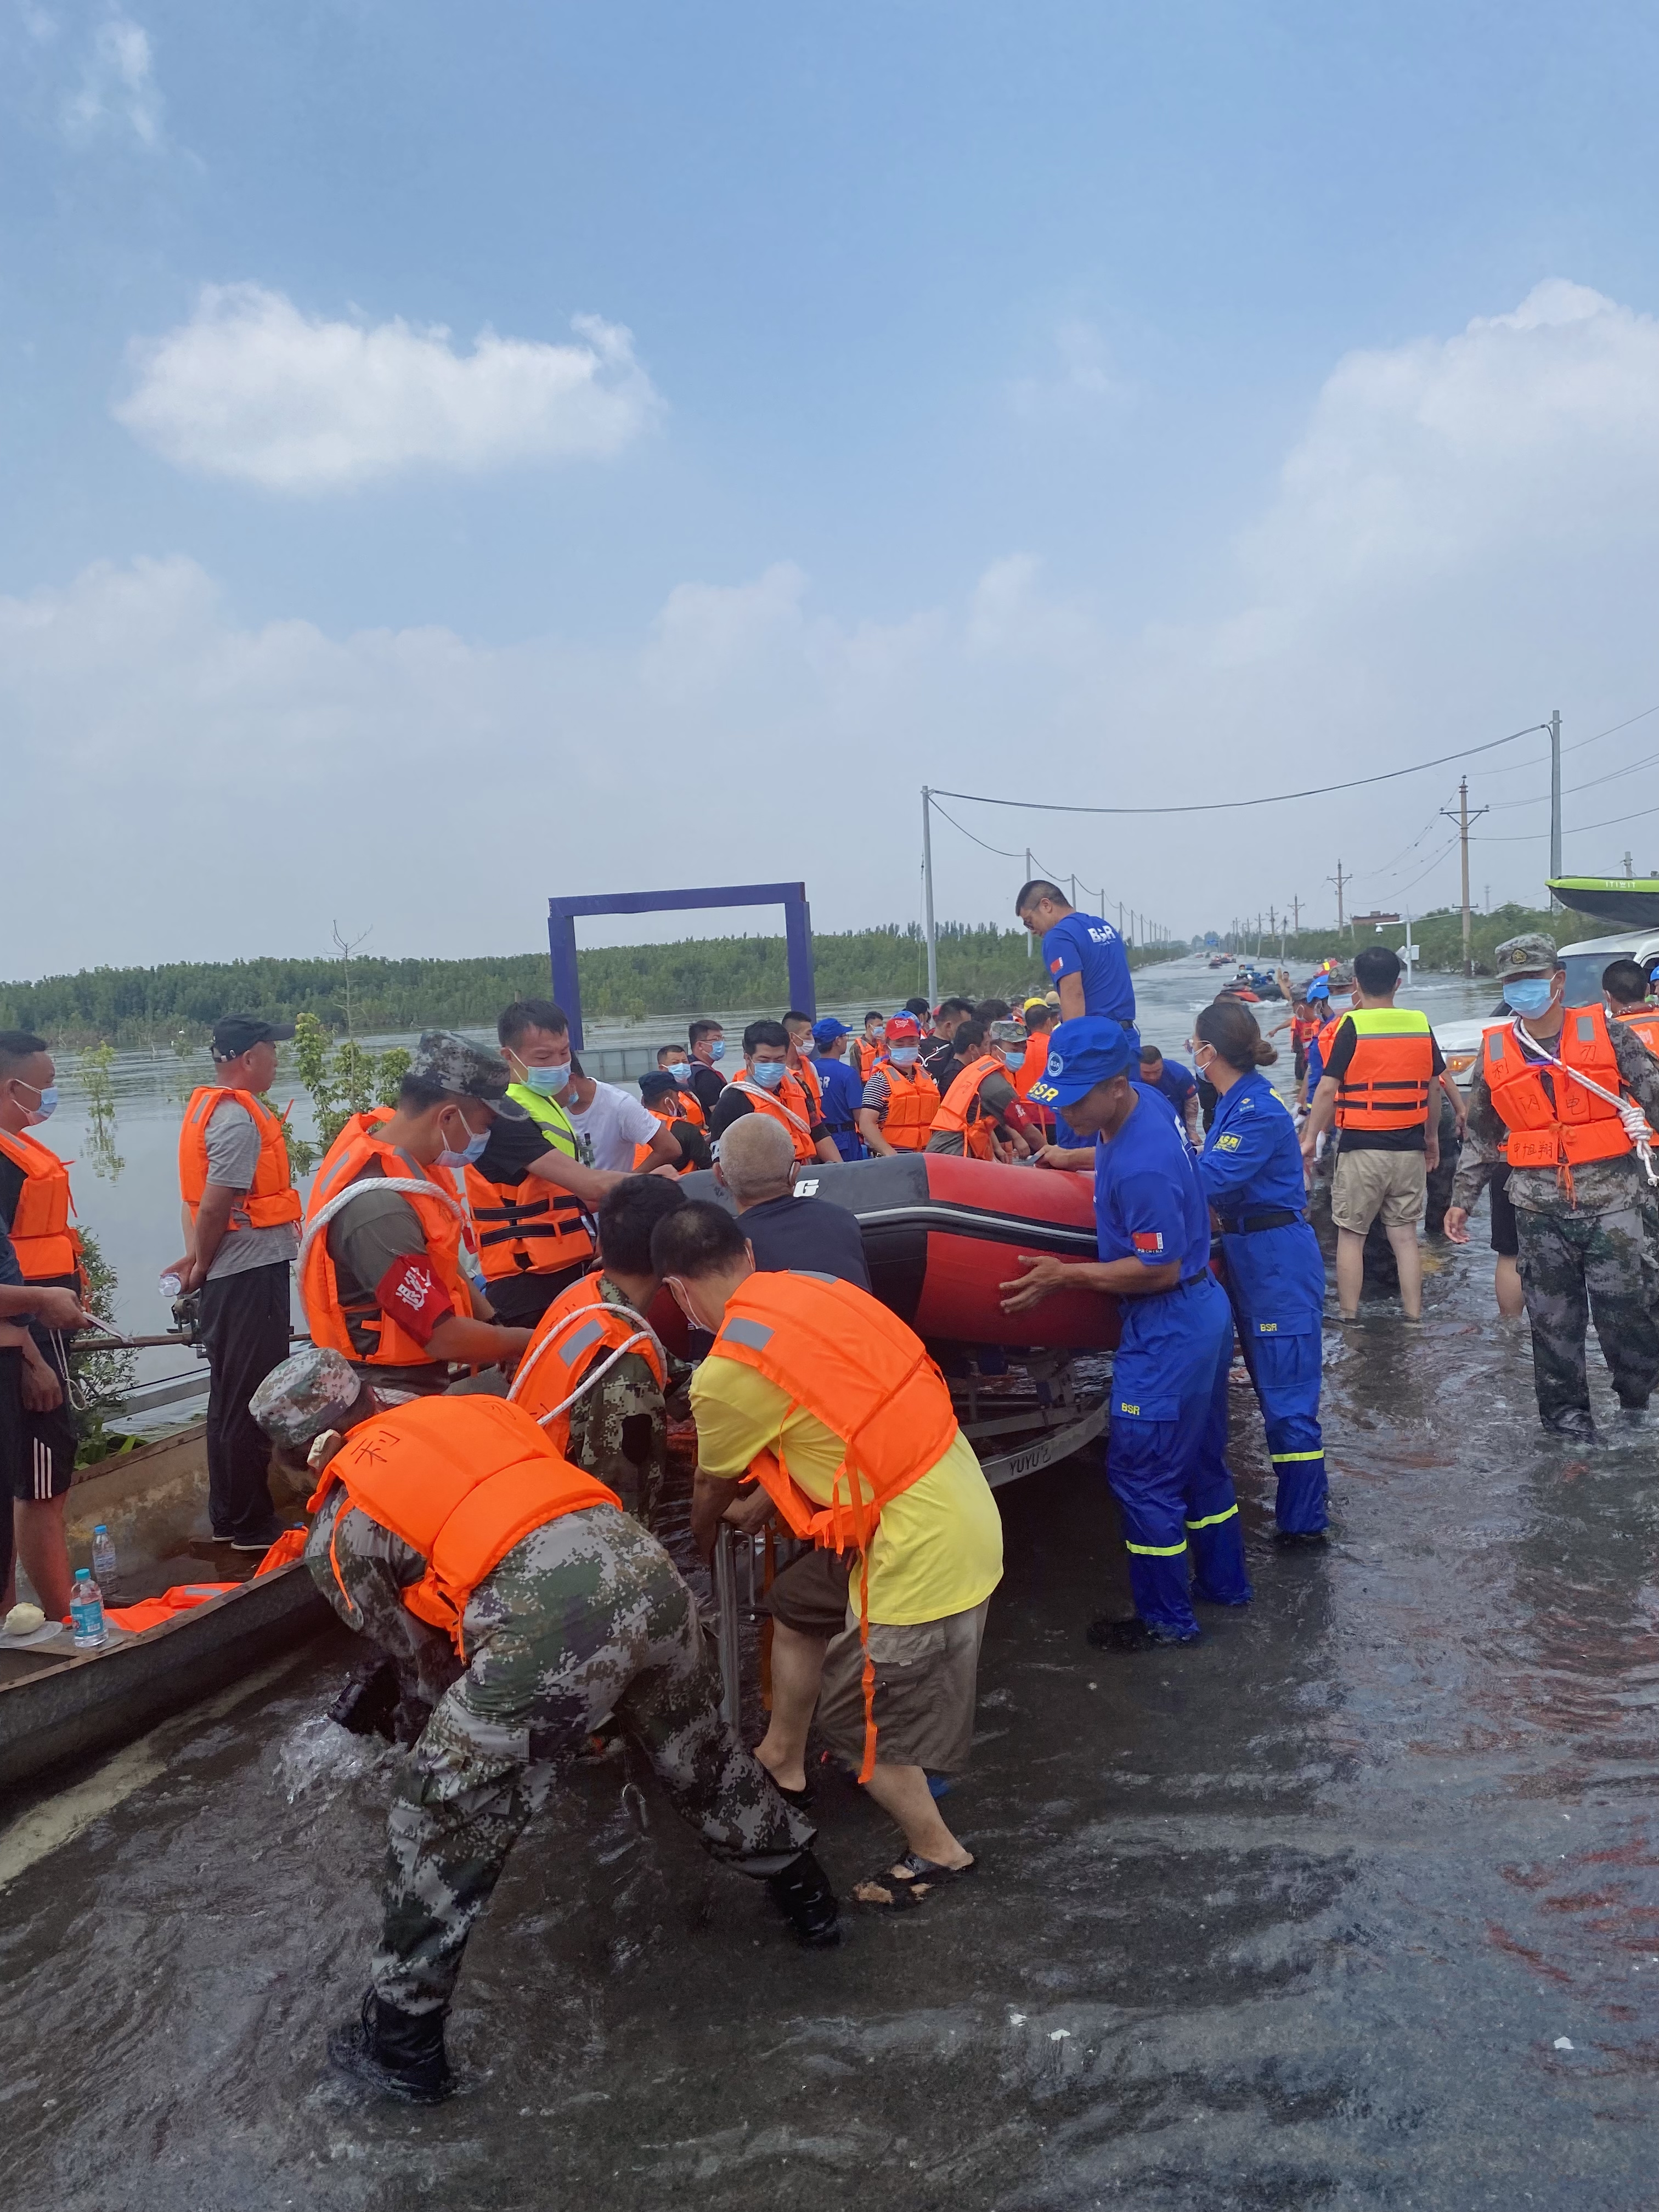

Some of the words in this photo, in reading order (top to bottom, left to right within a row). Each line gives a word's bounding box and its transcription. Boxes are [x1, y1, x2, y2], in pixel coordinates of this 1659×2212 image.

[1087, 925, 1116, 943] BSR
[1050, 1060, 1059, 1068] BSR
[1029, 1082, 1059, 1102] BSR
[1566, 1095, 1587, 1115] 电
[1260, 1323, 1277, 1332] BSR
[1121, 1402, 1140, 1415] BSR
